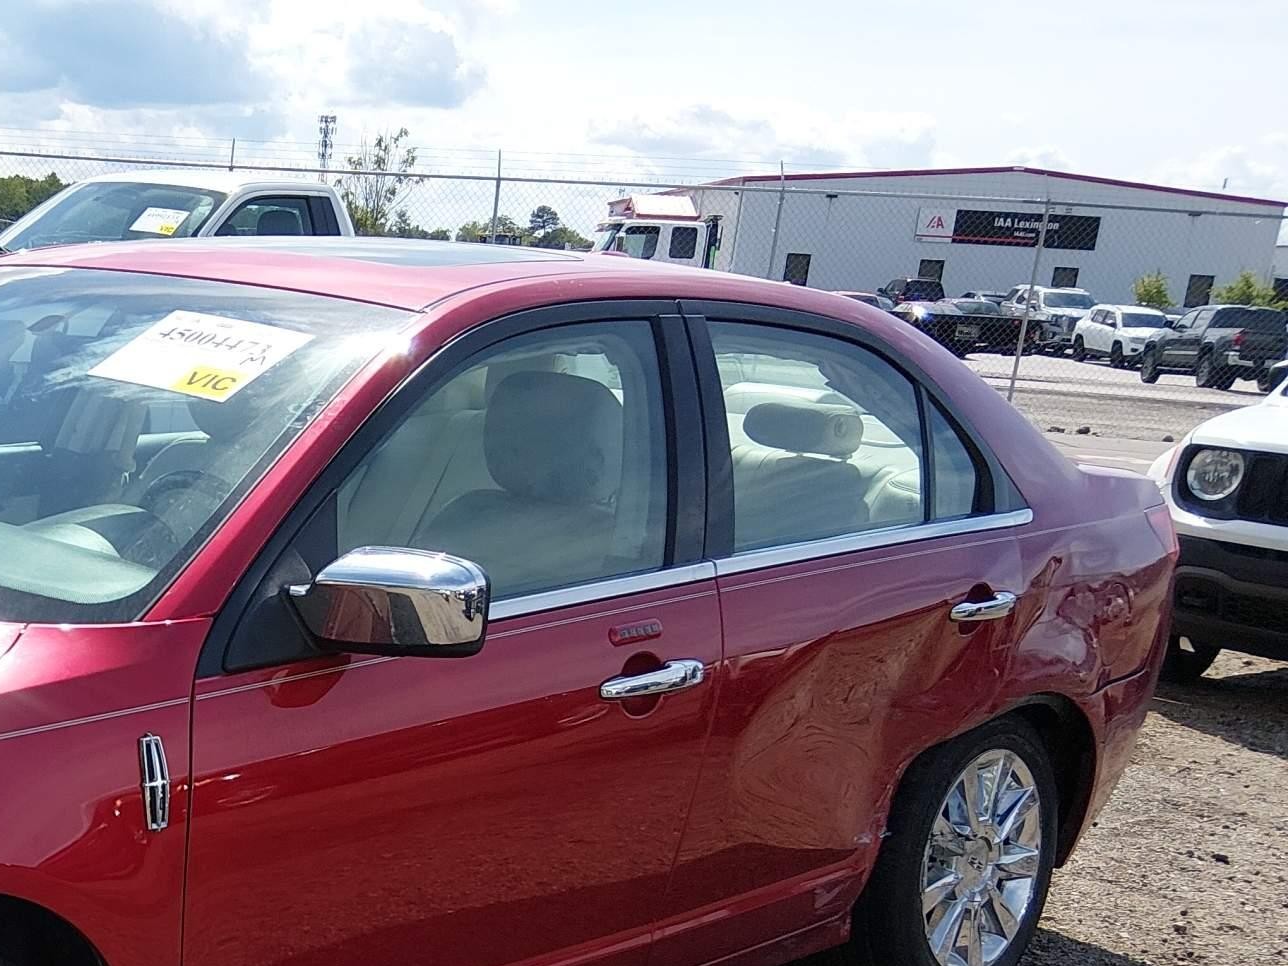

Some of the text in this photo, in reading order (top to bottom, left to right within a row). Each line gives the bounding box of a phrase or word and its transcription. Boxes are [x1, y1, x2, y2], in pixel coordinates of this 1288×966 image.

[994, 217, 1012, 228] IAA
[159, 326, 273, 355] 45004473
[186, 370, 237, 392] VIC
